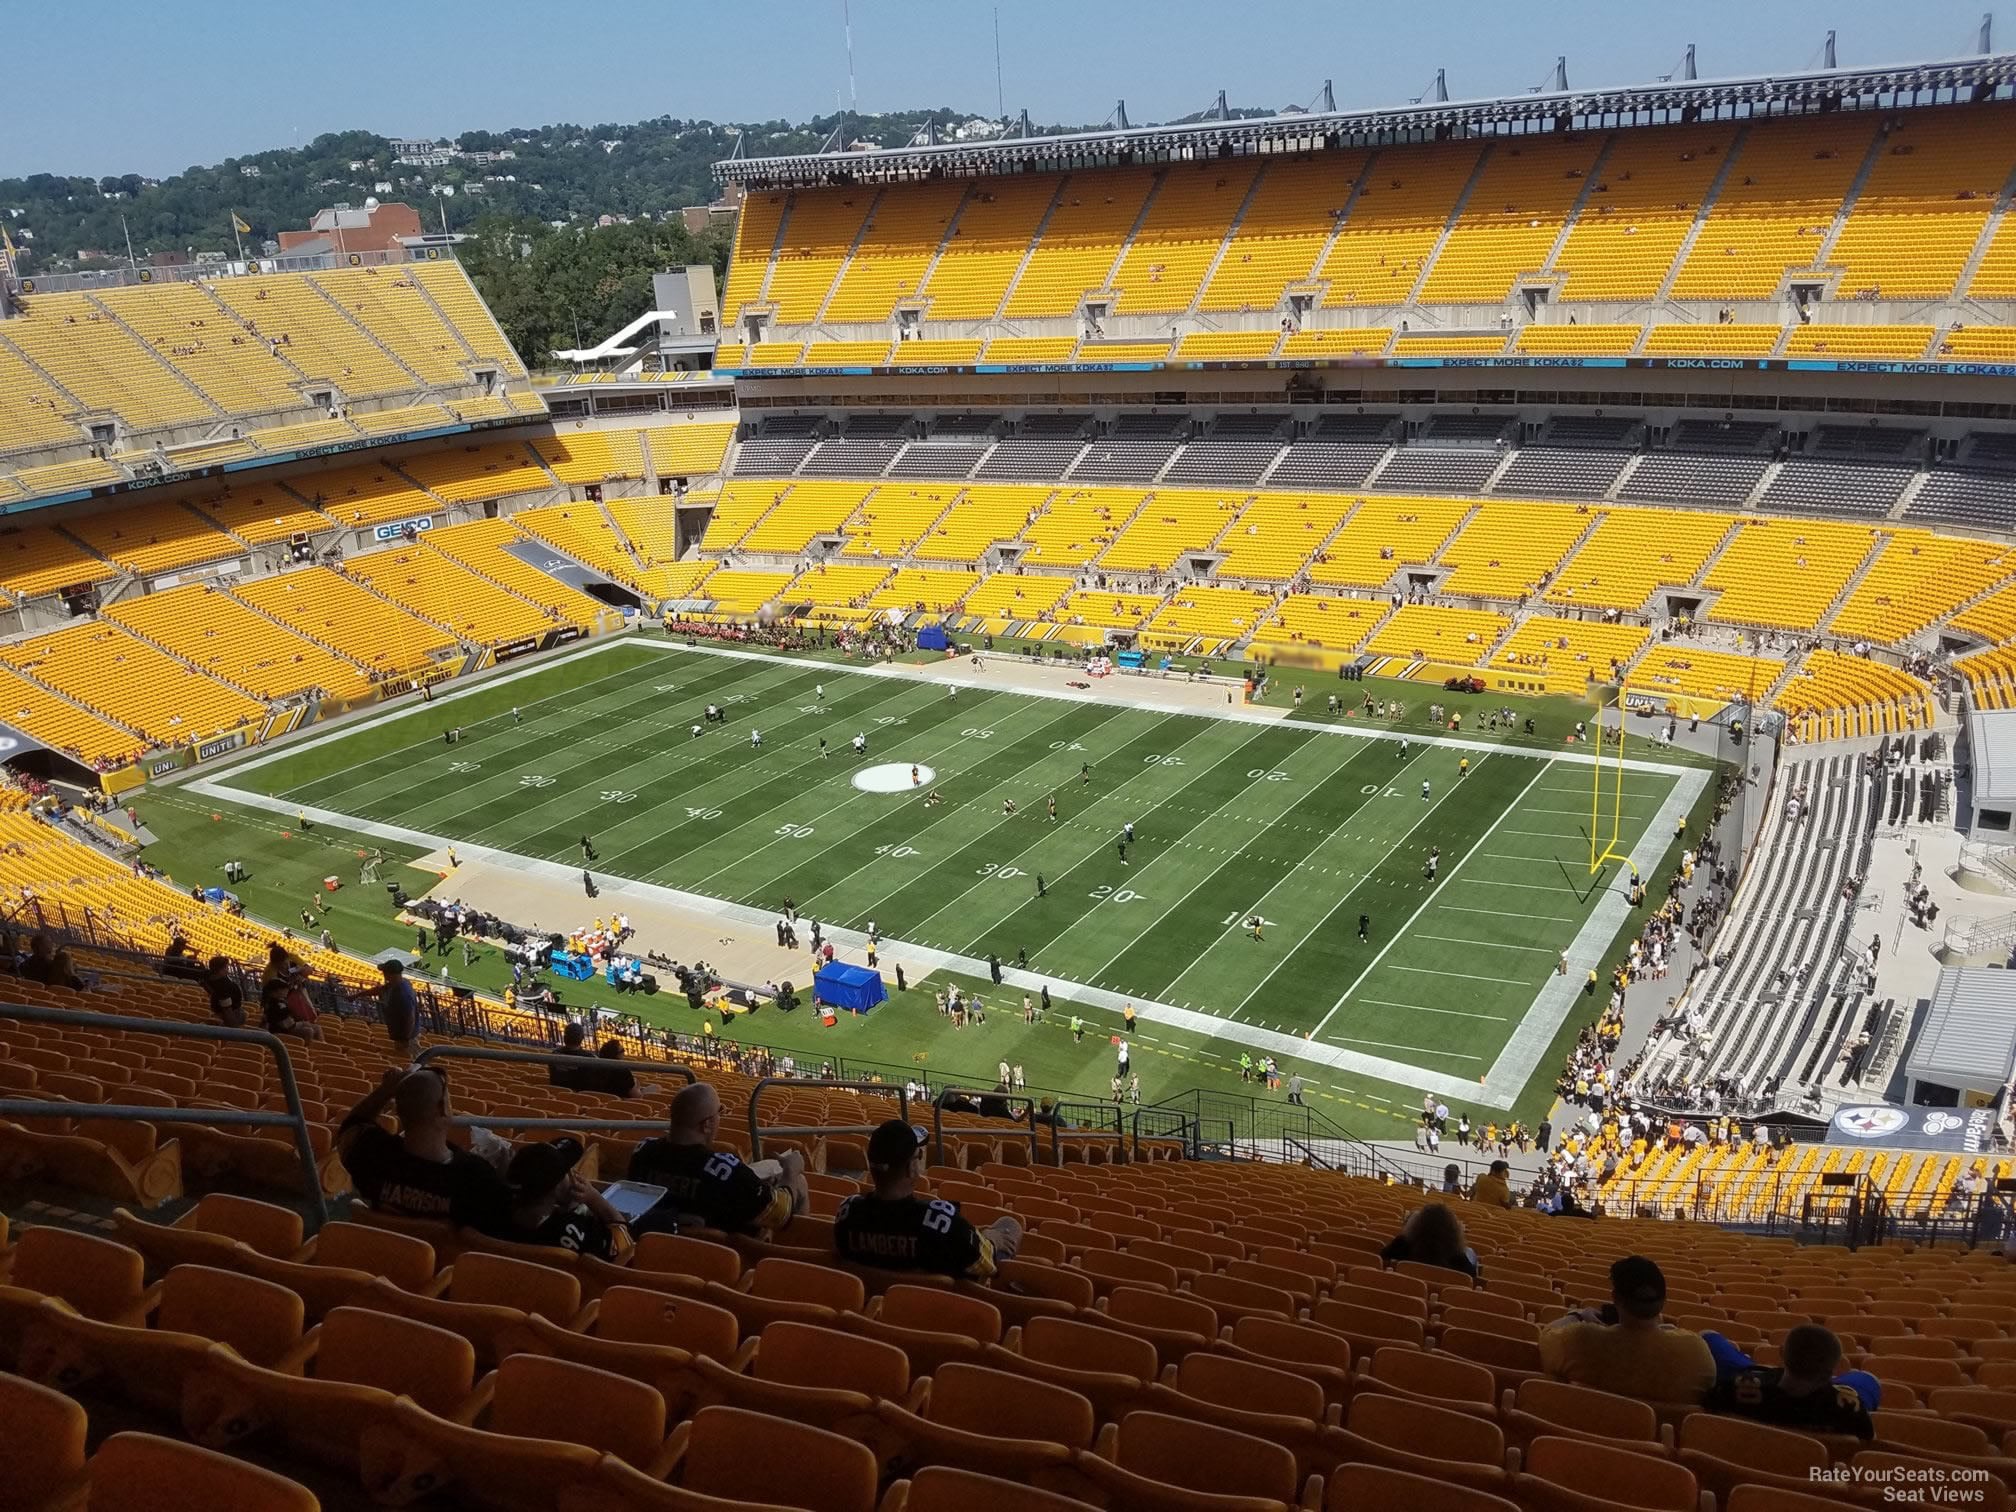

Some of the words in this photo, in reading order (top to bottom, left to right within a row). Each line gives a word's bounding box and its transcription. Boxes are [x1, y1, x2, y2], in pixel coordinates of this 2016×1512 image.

[899, 366, 948, 374] KDKA.COM
[1005, 364, 1043, 373] EXPECT
[1046, 364, 1073, 372] MORE
[1443, 359, 1490, 367] EXPECT
[1494, 359, 1530, 367] MORE
[1668, 359, 1743, 369] KDKA.COM
[1837, 362, 1896, 373] EXPECT
[1902, 363, 1948, 374] MORE
[742, 368, 777, 376] EXPECT
[780, 368, 806, 376] MORE
[295, 446, 335, 459] EXPECT
[338, 440, 368, 451] MORE
[128, 472, 191, 490] KDKA.COM
[377, 518, 431, 539] GEICO
[960, 728, 994, 739] 50
[201, 741, 233, 758] UNITE
[154, 761, 178, 774] UNI
[774, 823, 814, 838] 50
[874, 843, 913, 857] 40
[975, 863, 1019, 879] 30
[1088, 885, 1135, 902] 20
[922, 1199, 956, 1234] 58
[560, 1224, 585, 1250] 92
[848, 1231, 918, 1259] LAMBERT
